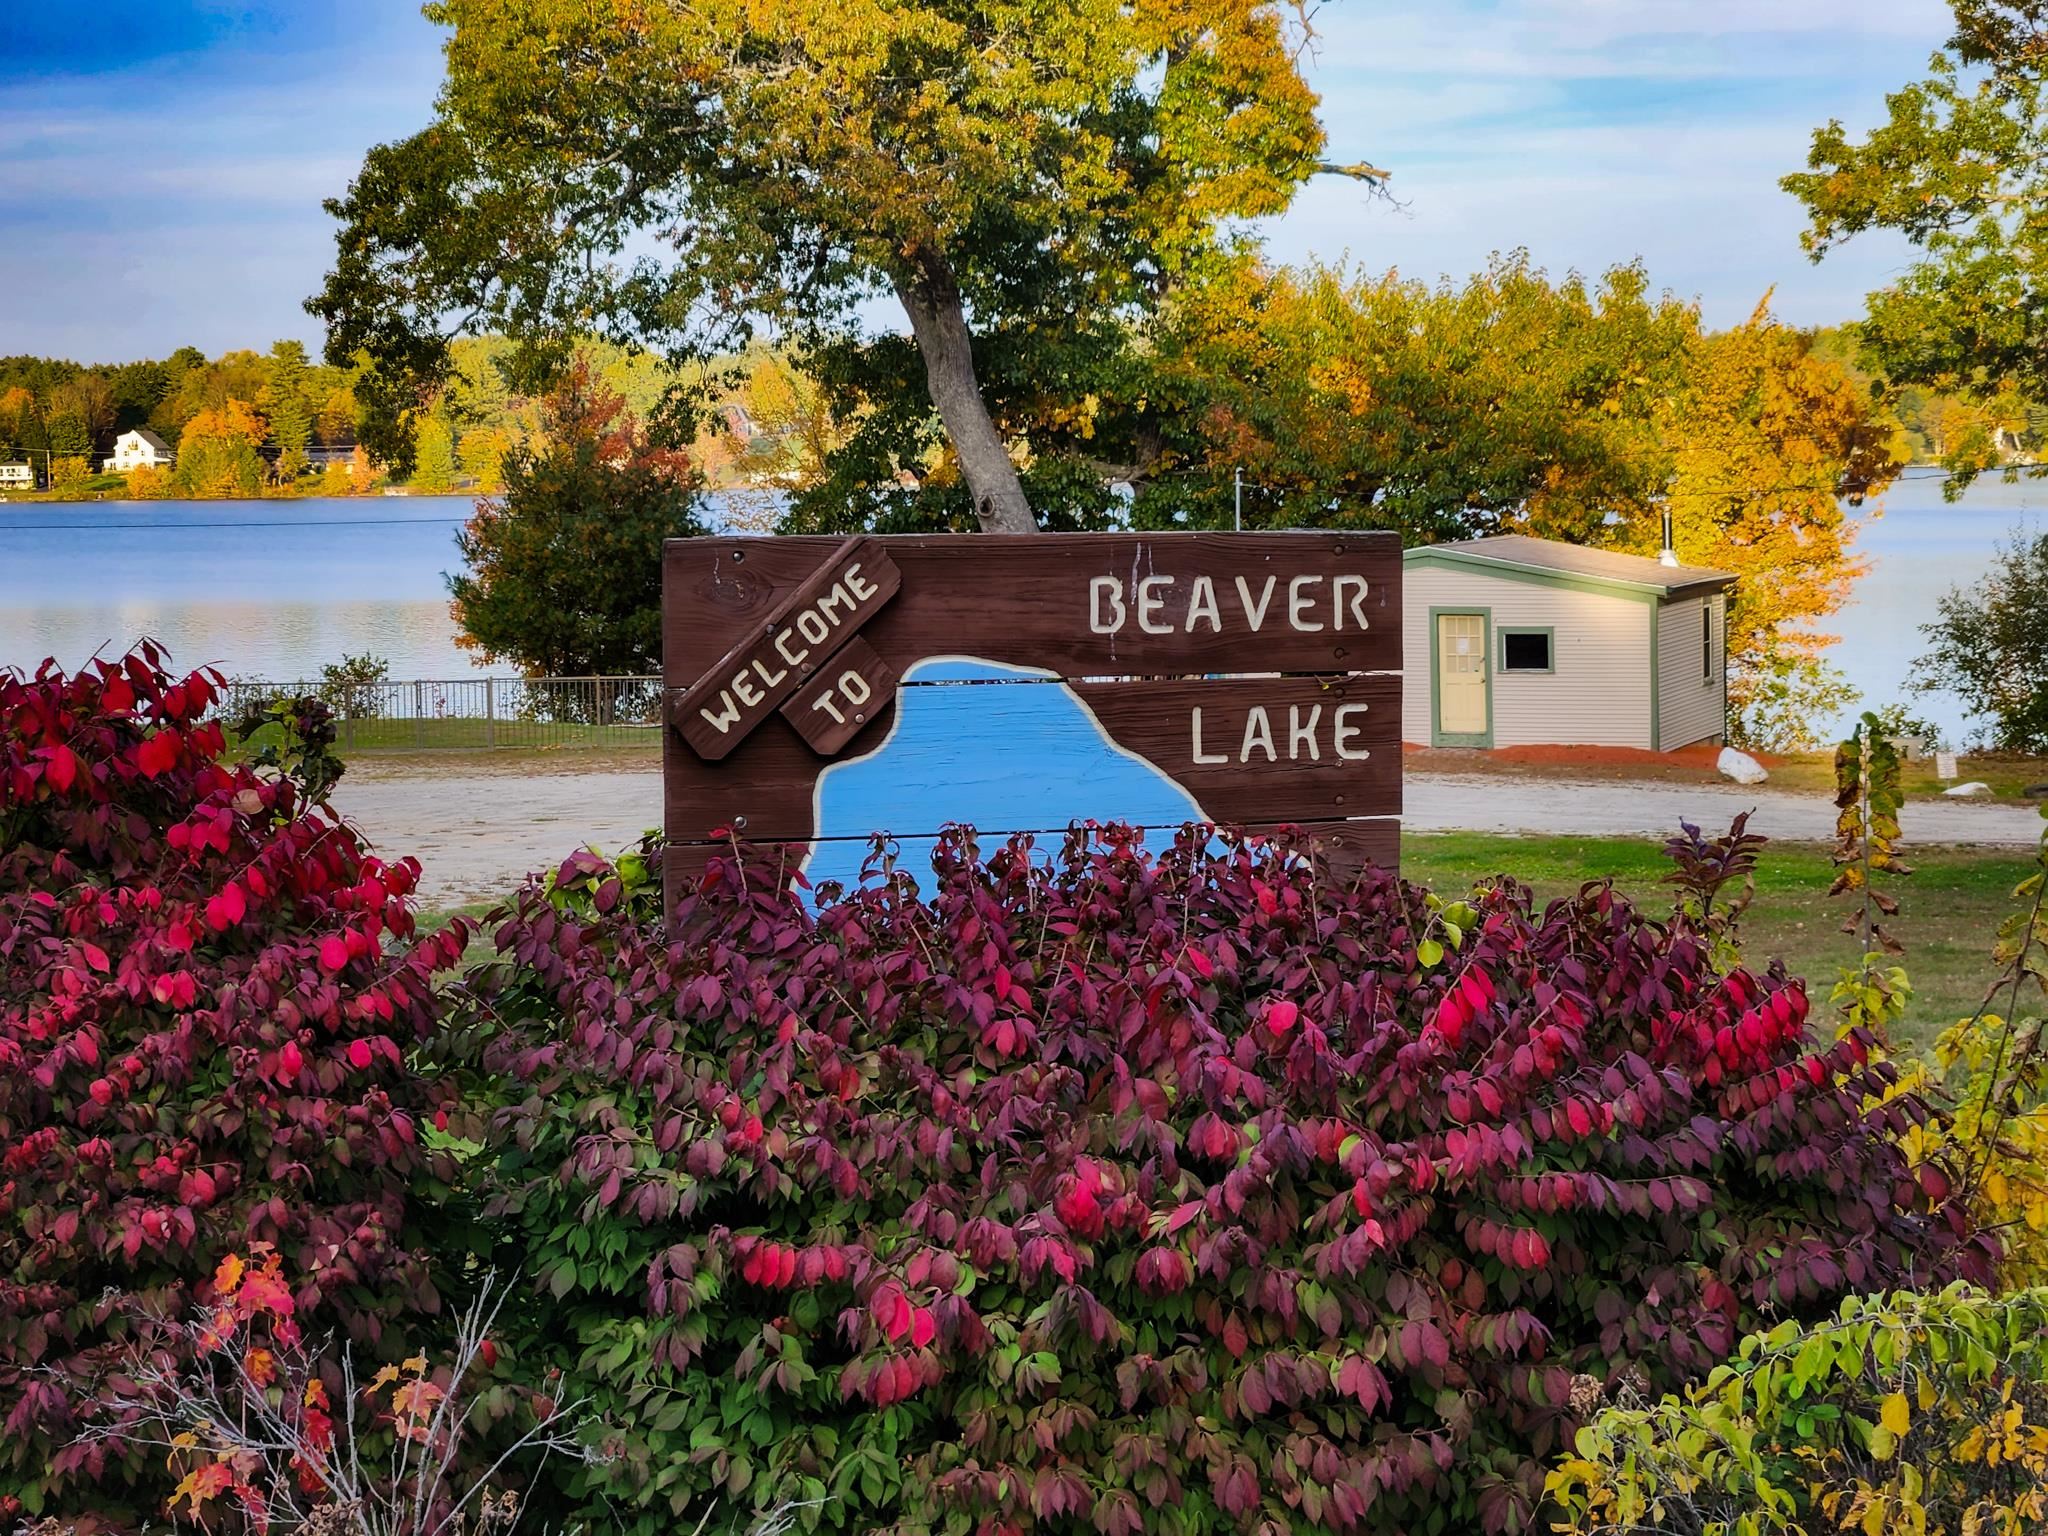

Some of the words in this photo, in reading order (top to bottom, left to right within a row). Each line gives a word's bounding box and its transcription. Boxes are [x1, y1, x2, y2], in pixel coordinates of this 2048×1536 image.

[1089, 575, 1369, 634] BEAVER
[700, 563, 879, 734] WELCOME
[812, 670, 871, 724] TO
[1192, 703, 1370, 764] LAKE
